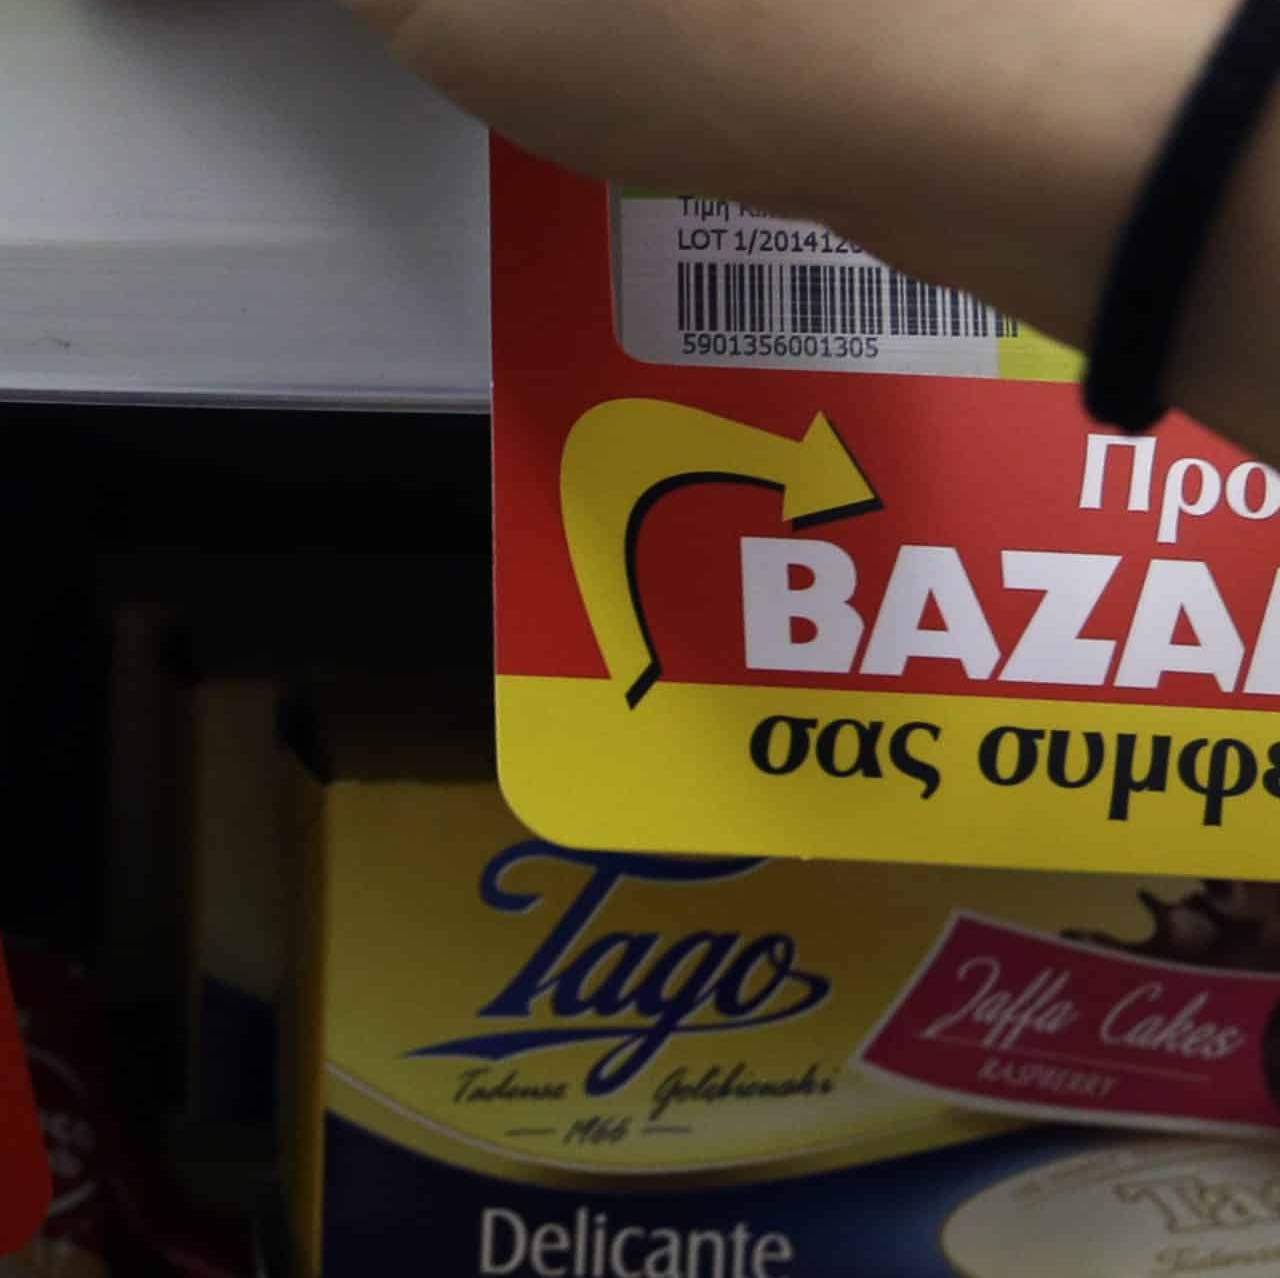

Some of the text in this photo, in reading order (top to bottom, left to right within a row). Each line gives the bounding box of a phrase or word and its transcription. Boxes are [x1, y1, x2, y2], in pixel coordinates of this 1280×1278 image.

[677, 228, 729, 251] LOT
[681, 333, 880, 359] 5901356001305
[748, 714, 942, 799] σας
[472, 836, 833, 1096] Tago
[915, 955, 1246, 1061] Jaffa Cakes
[479, 1206, 795, 1278] Delicante
